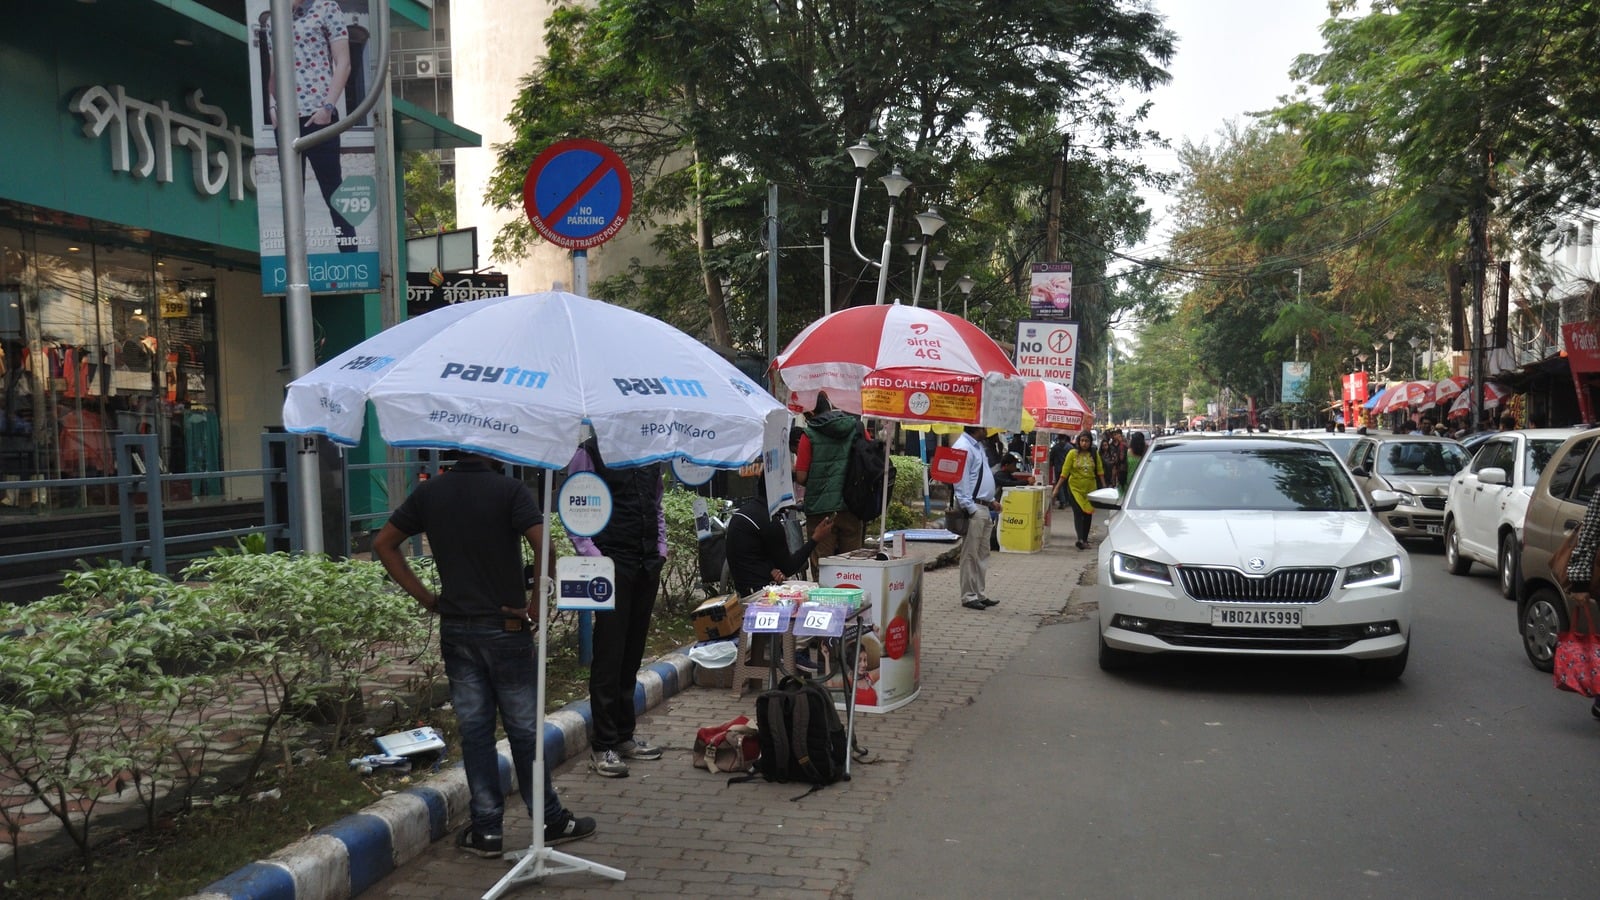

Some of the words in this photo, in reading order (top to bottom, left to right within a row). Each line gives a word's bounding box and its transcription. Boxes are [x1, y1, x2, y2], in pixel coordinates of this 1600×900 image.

[580, 206, 593, 216] NO
[567, 216, 605, 225] PARKING
[531, 215, 575, 247] BIDHANNAGAR
[575, 234, 605, 247] TRAFFIC
[604, 215, 624, 239] POLICE
[274, 262, 369, 287] ptaloons
[906, 337, 942, 348] airtel
[1020, 341, 1043, 353] NO
[914, 348, 942, 361] 4G
[1020, 355, 1073, 367] VEHICLE
[1019, 368, 1041, 378] WILL
[1044, 369, 1071, 379] MOVE
[895, 378, 928, 390] CALLS
[929, 382, 950, 392] AND
[952, 383, 975, 394] DATA
[429, 410, 519, 434] #PaytmKaro
[640, 420, 716, 440] #PaytmKaro
[1007, 516, 1024, 525] idea
[842, 571, 863, 581] airtel
[758, 616, 776, 627] 40
[806, 615, 826, 628] 50
[1221, 610, 1300, 625] WB02AK5999
